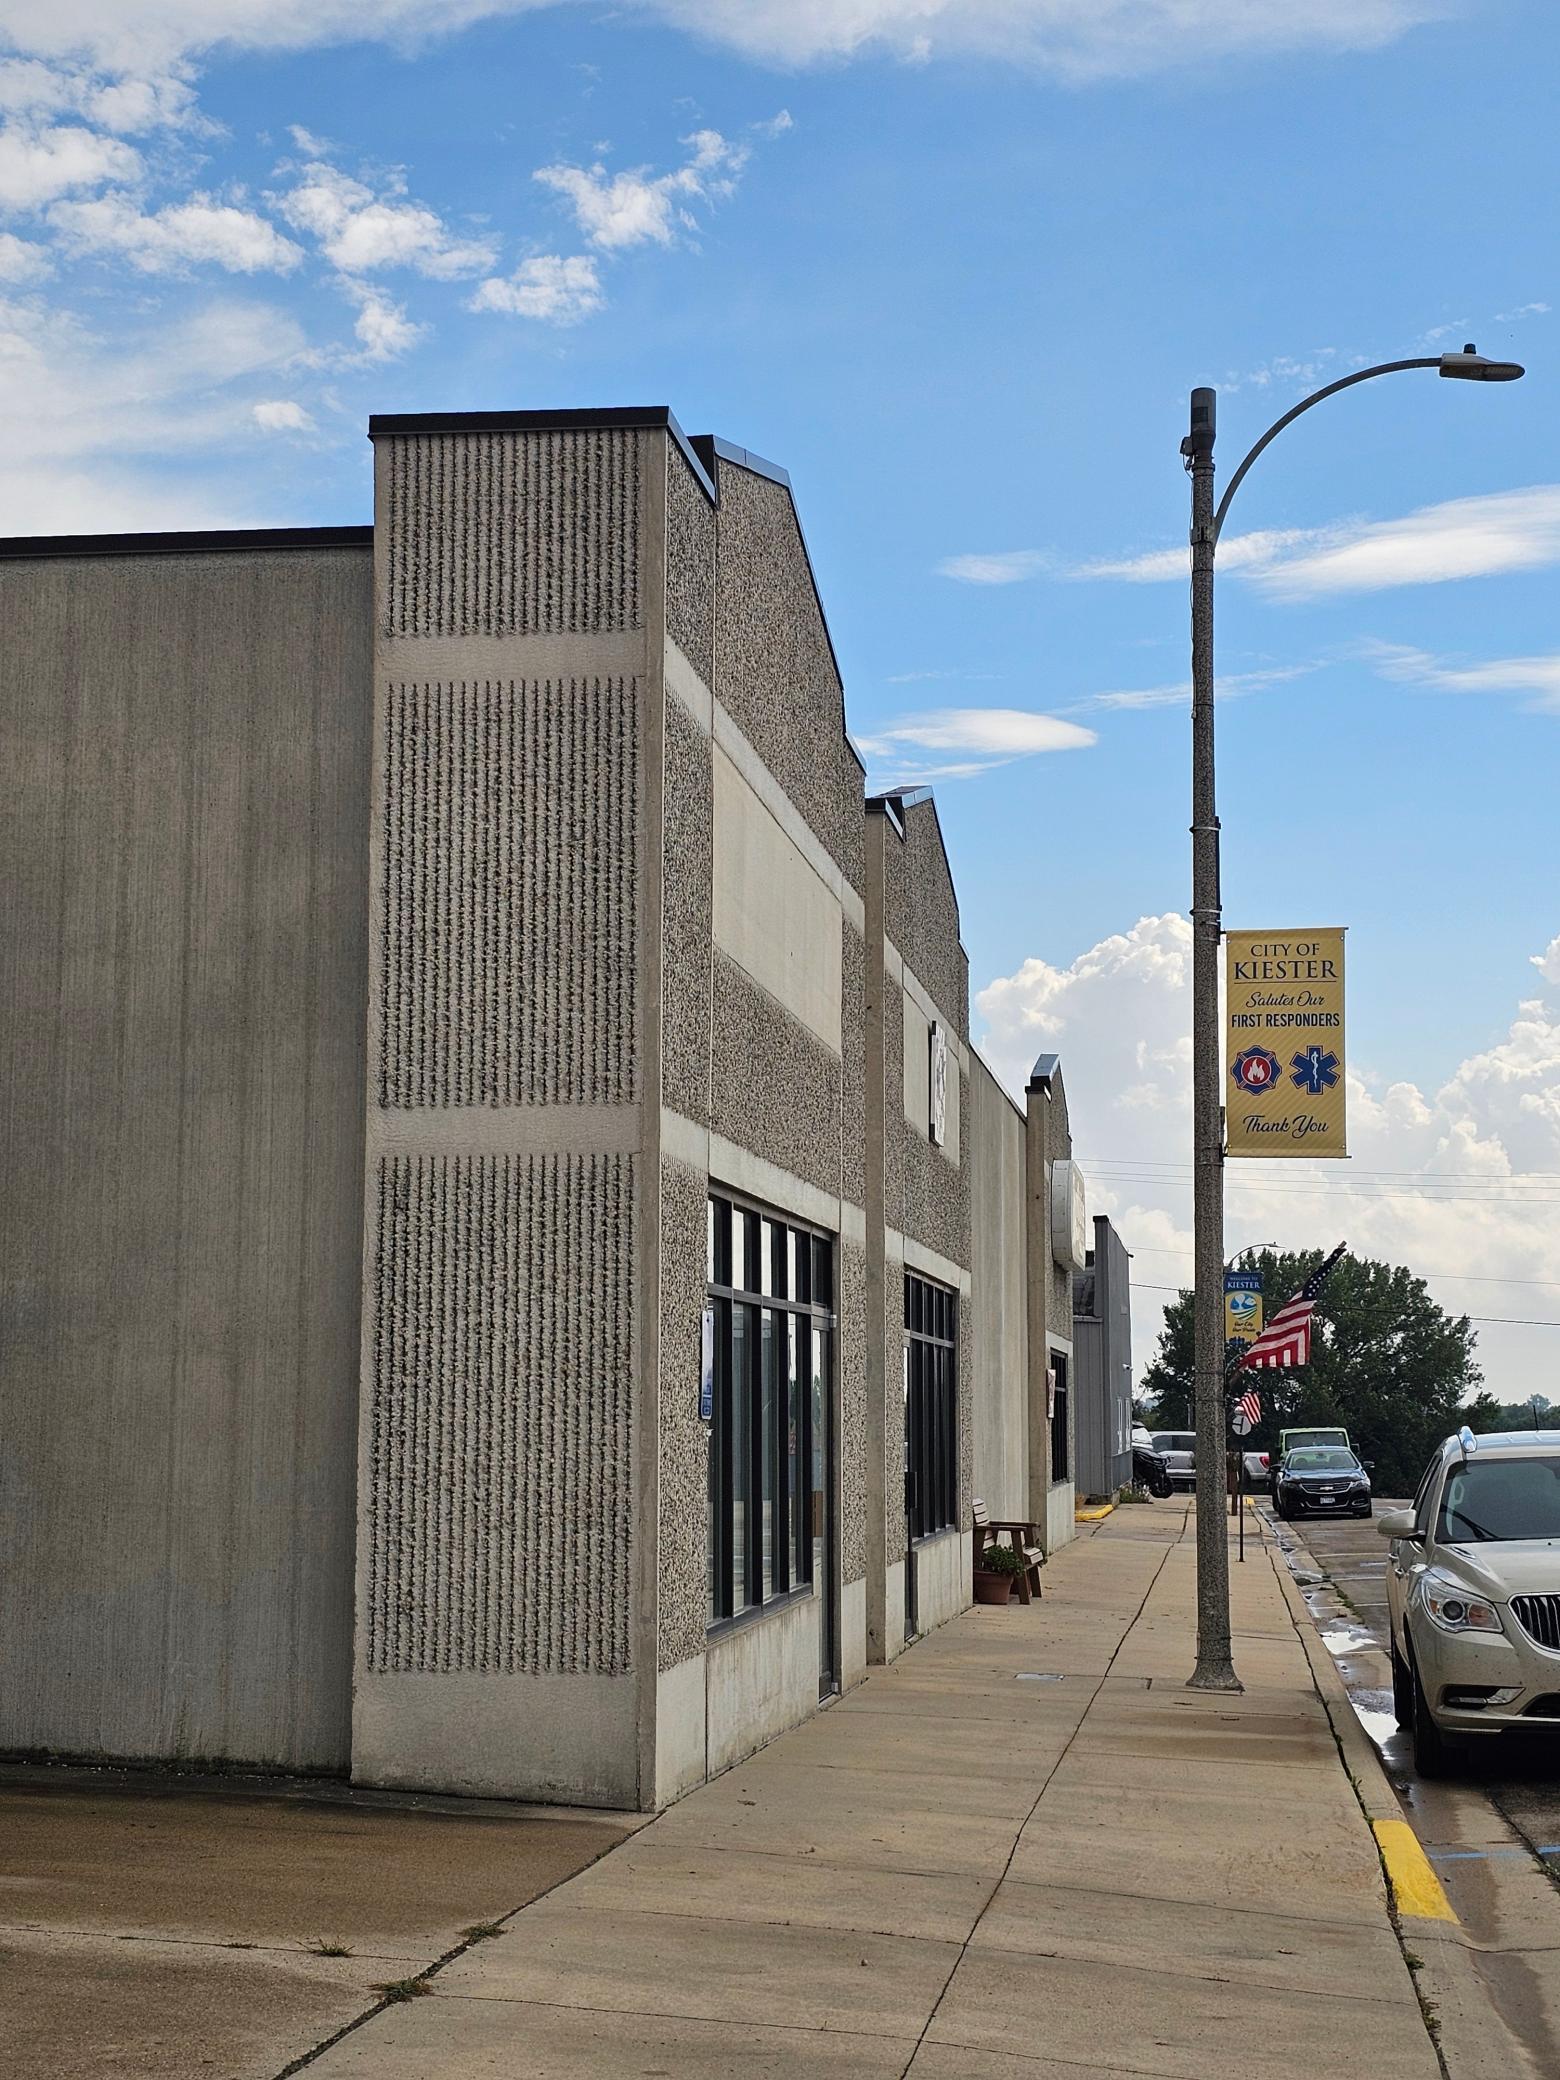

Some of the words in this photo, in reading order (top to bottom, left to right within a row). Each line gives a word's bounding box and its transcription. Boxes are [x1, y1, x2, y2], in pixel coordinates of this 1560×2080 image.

[1250, 943, 1292, 957] CITY
[1296, 943, 1320, 956] OF
[1233, 960, 1339, 979] KIESTER
[1245, 991, 1295, 1008] Salutes
[1297, 990, 1325, 1007] Our
[1231, 1013, 1262, 1028] FIRST
[1266, 1012, 1340, 1027] RESPONDERS
[1242, 1115, 1290, 1133] Thank
[1291, 1114, 1329, 1139] You
